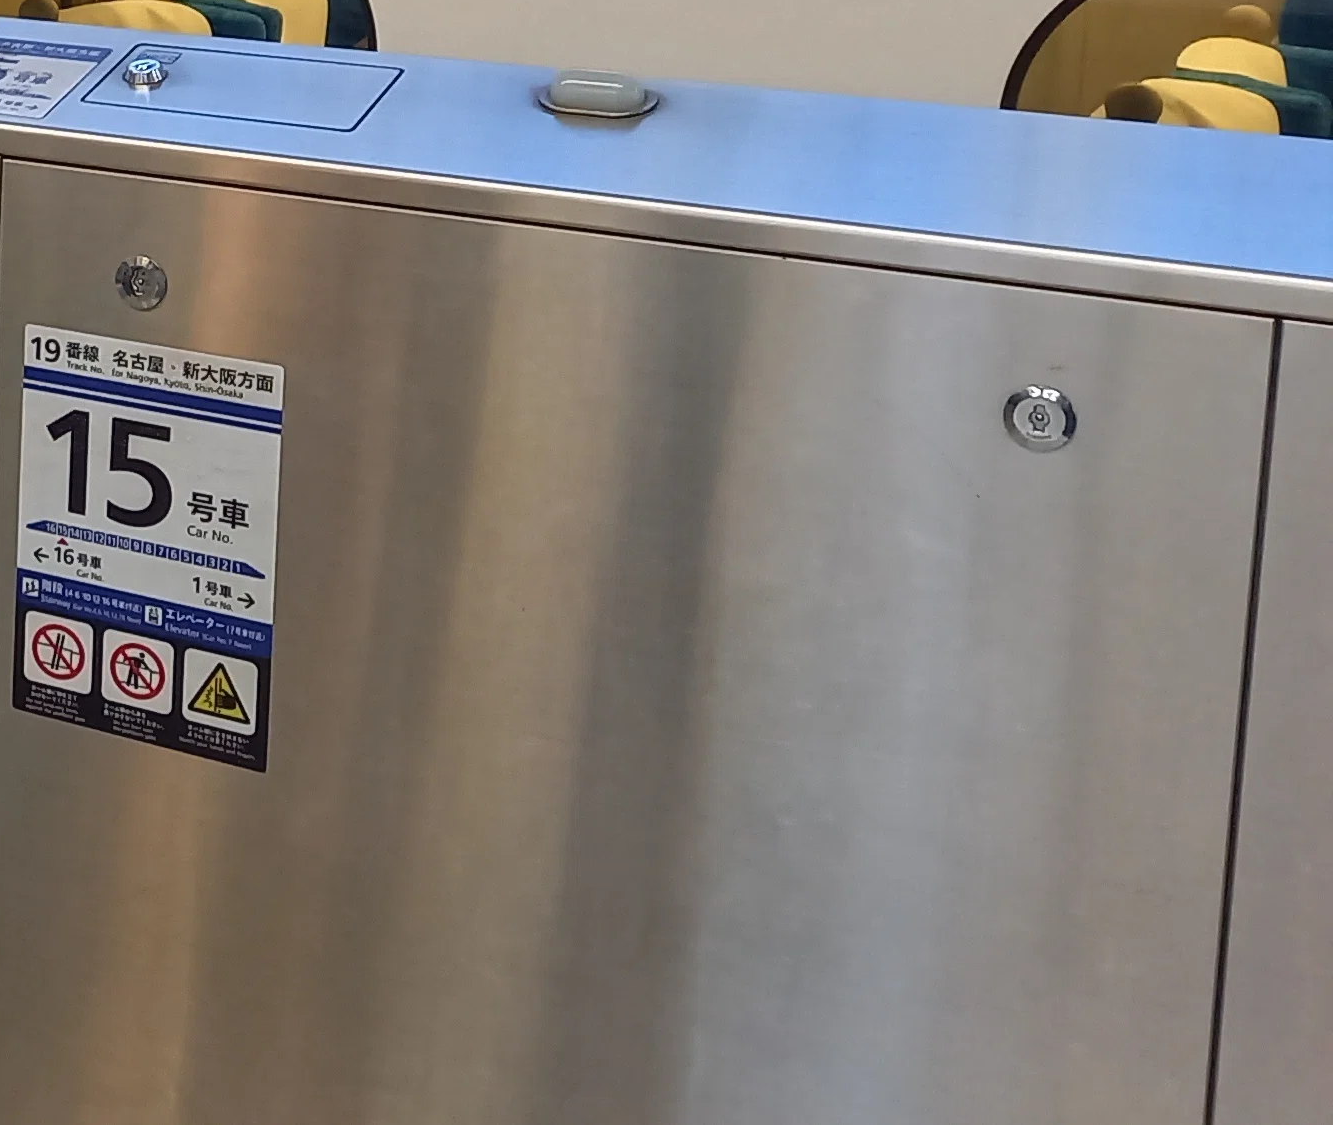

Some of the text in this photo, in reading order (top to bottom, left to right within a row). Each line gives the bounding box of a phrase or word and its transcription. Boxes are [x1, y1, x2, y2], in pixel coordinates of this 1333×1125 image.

[67, 360, 88, 373] Track
[111, 369, 124, 379] for
[126, 372, 162, 386] Nagoya,
[46, 409, 173, 528] 15
[186, 525, 233, 545] Car No.
[204, 598, 217, 608] Car
